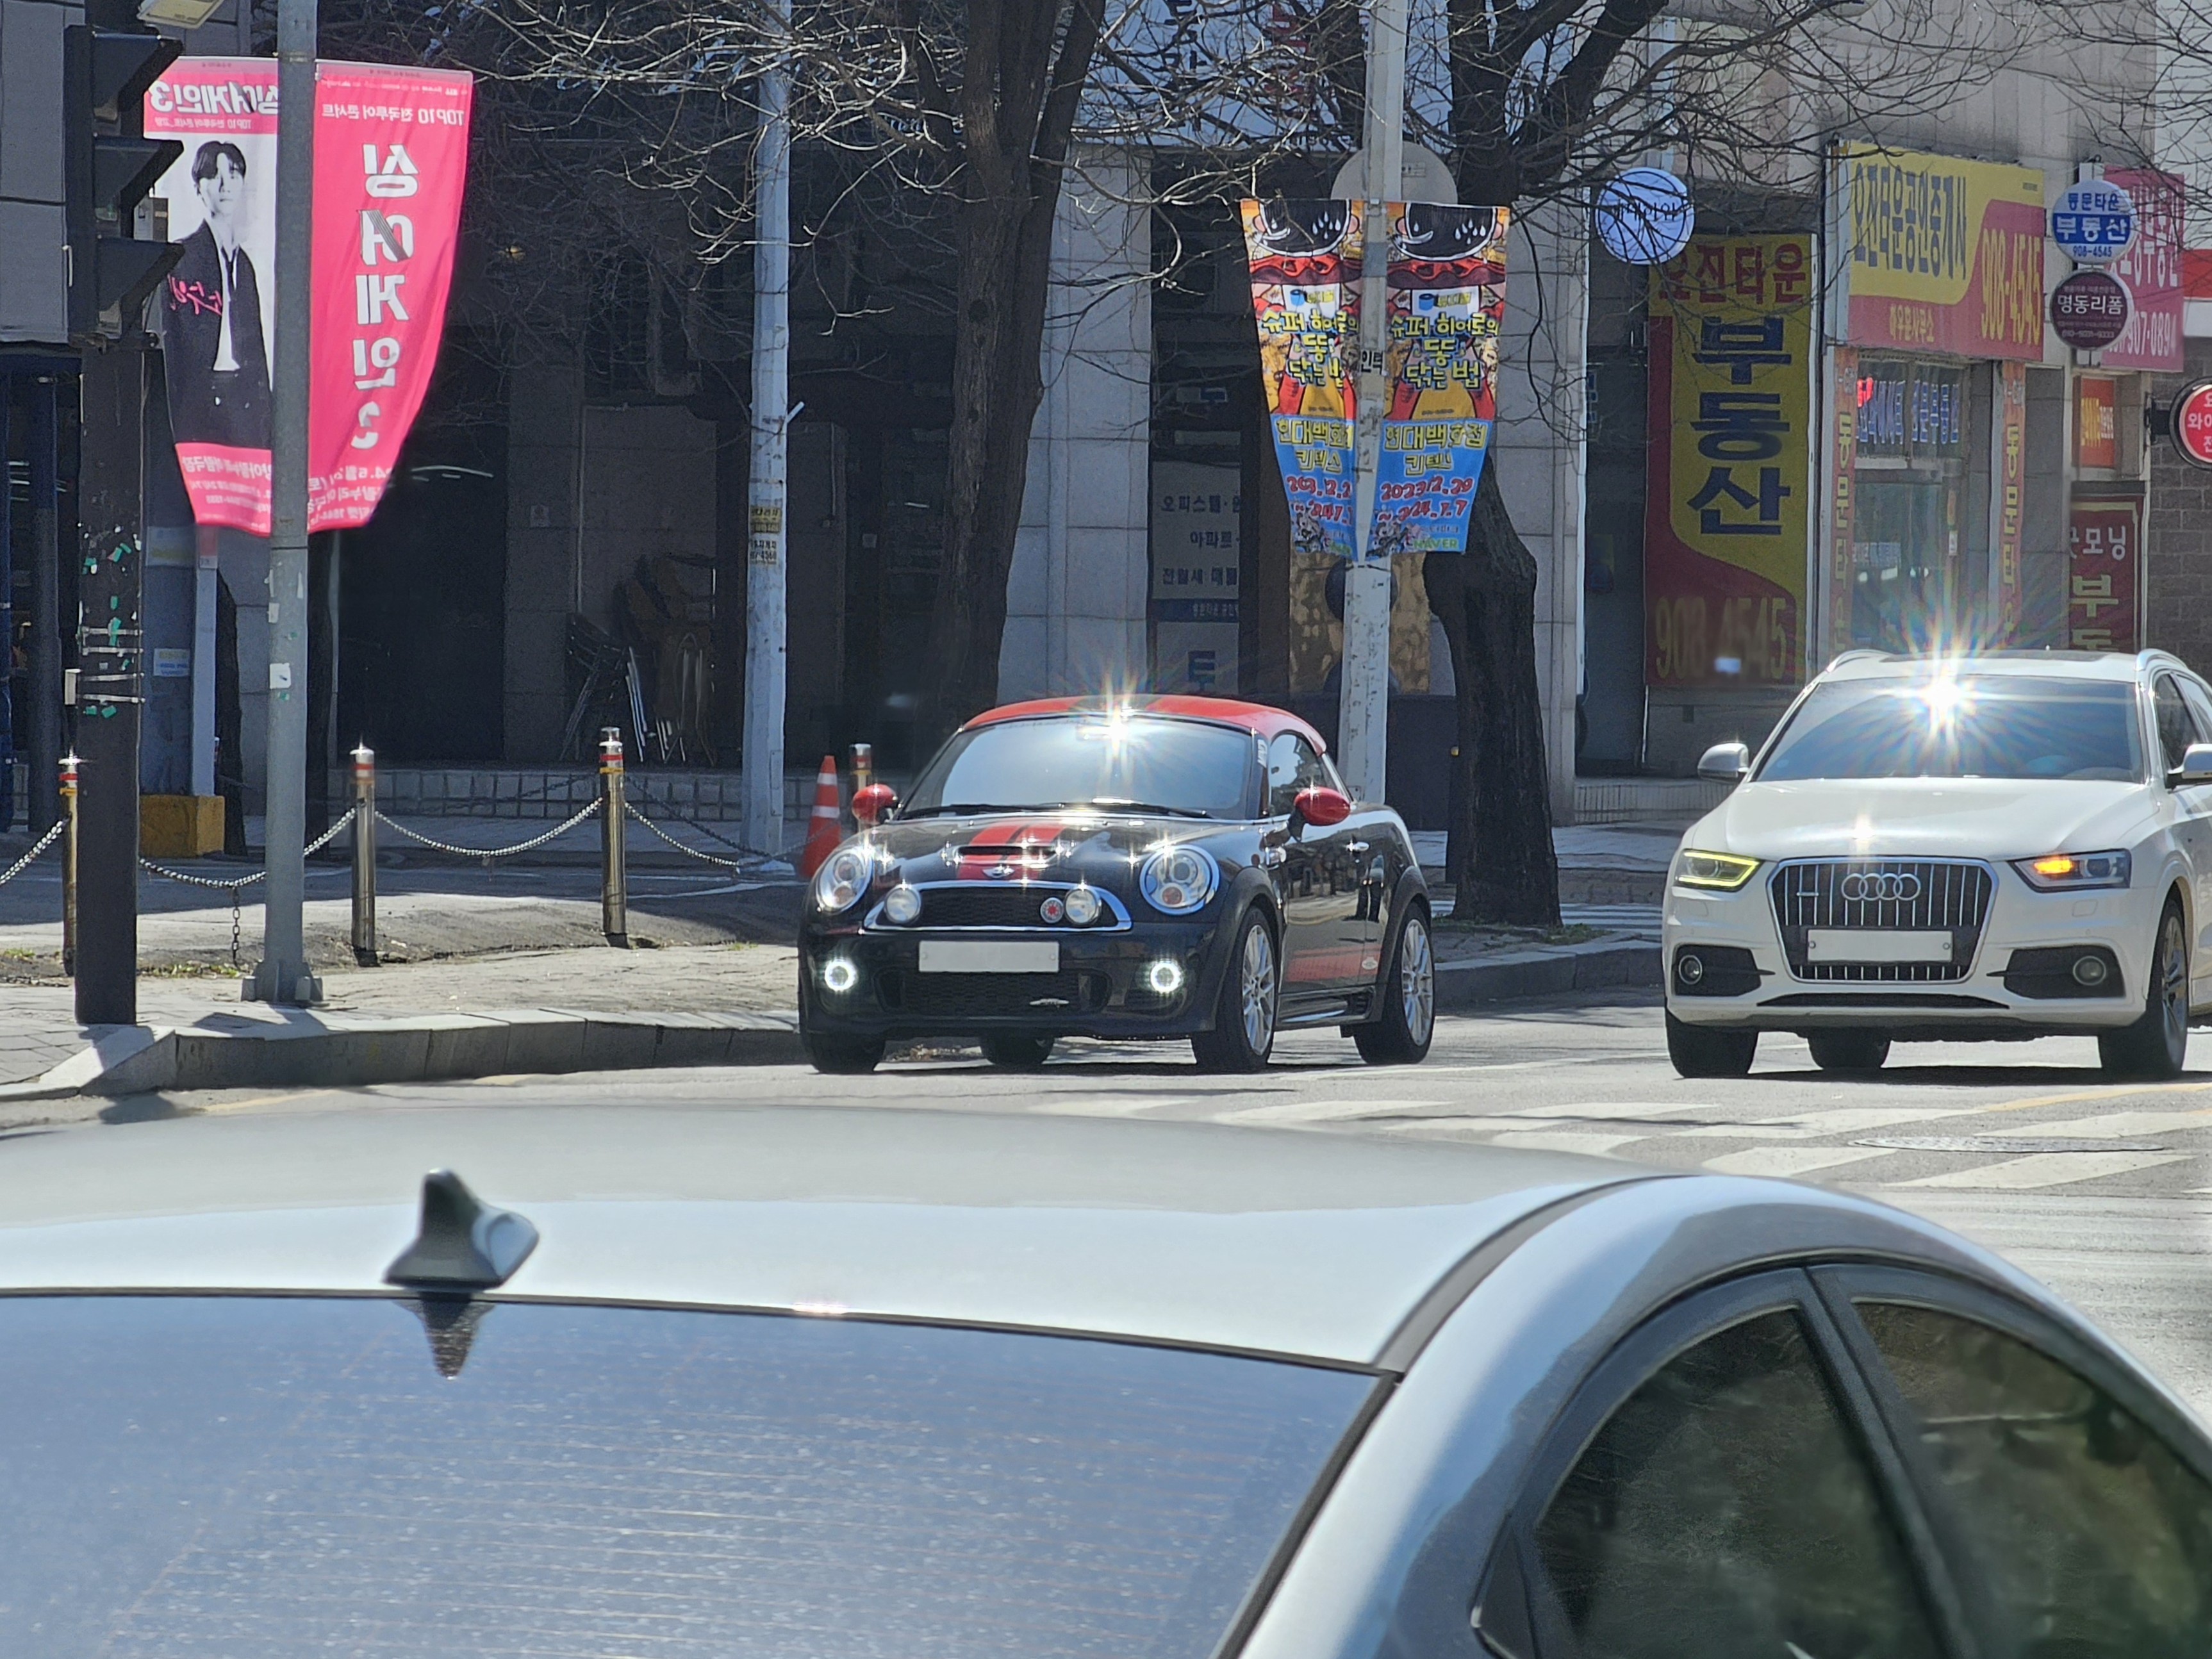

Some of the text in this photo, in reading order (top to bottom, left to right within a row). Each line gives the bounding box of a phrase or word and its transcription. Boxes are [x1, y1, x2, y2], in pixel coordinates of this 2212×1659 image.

[2067, 192, 2120, 211] 동문타운
[2056, 216, 2128, 242] 부동산
[2072, 245, 2113, 258] 908-4545
[1981, 228, 2042, 346] 908-4545
[2056, 293, 2124, 315] 명동리폼
[1262, 310, 1306, 334] 슈퍼
[1391, 311, 1500, 339] 슈퍼 히어로의
[1423, 338, 1458, 367] 똥
[1406, 359, 1482, 390] 닦는 법
[1276, 418, 1353, 450] 현대백화
[1384, 423, 1487, 450] 현대백화점
[1686, 316, 1792, 535] 부동산
[1413, 538, 1458, 550] NAVER
